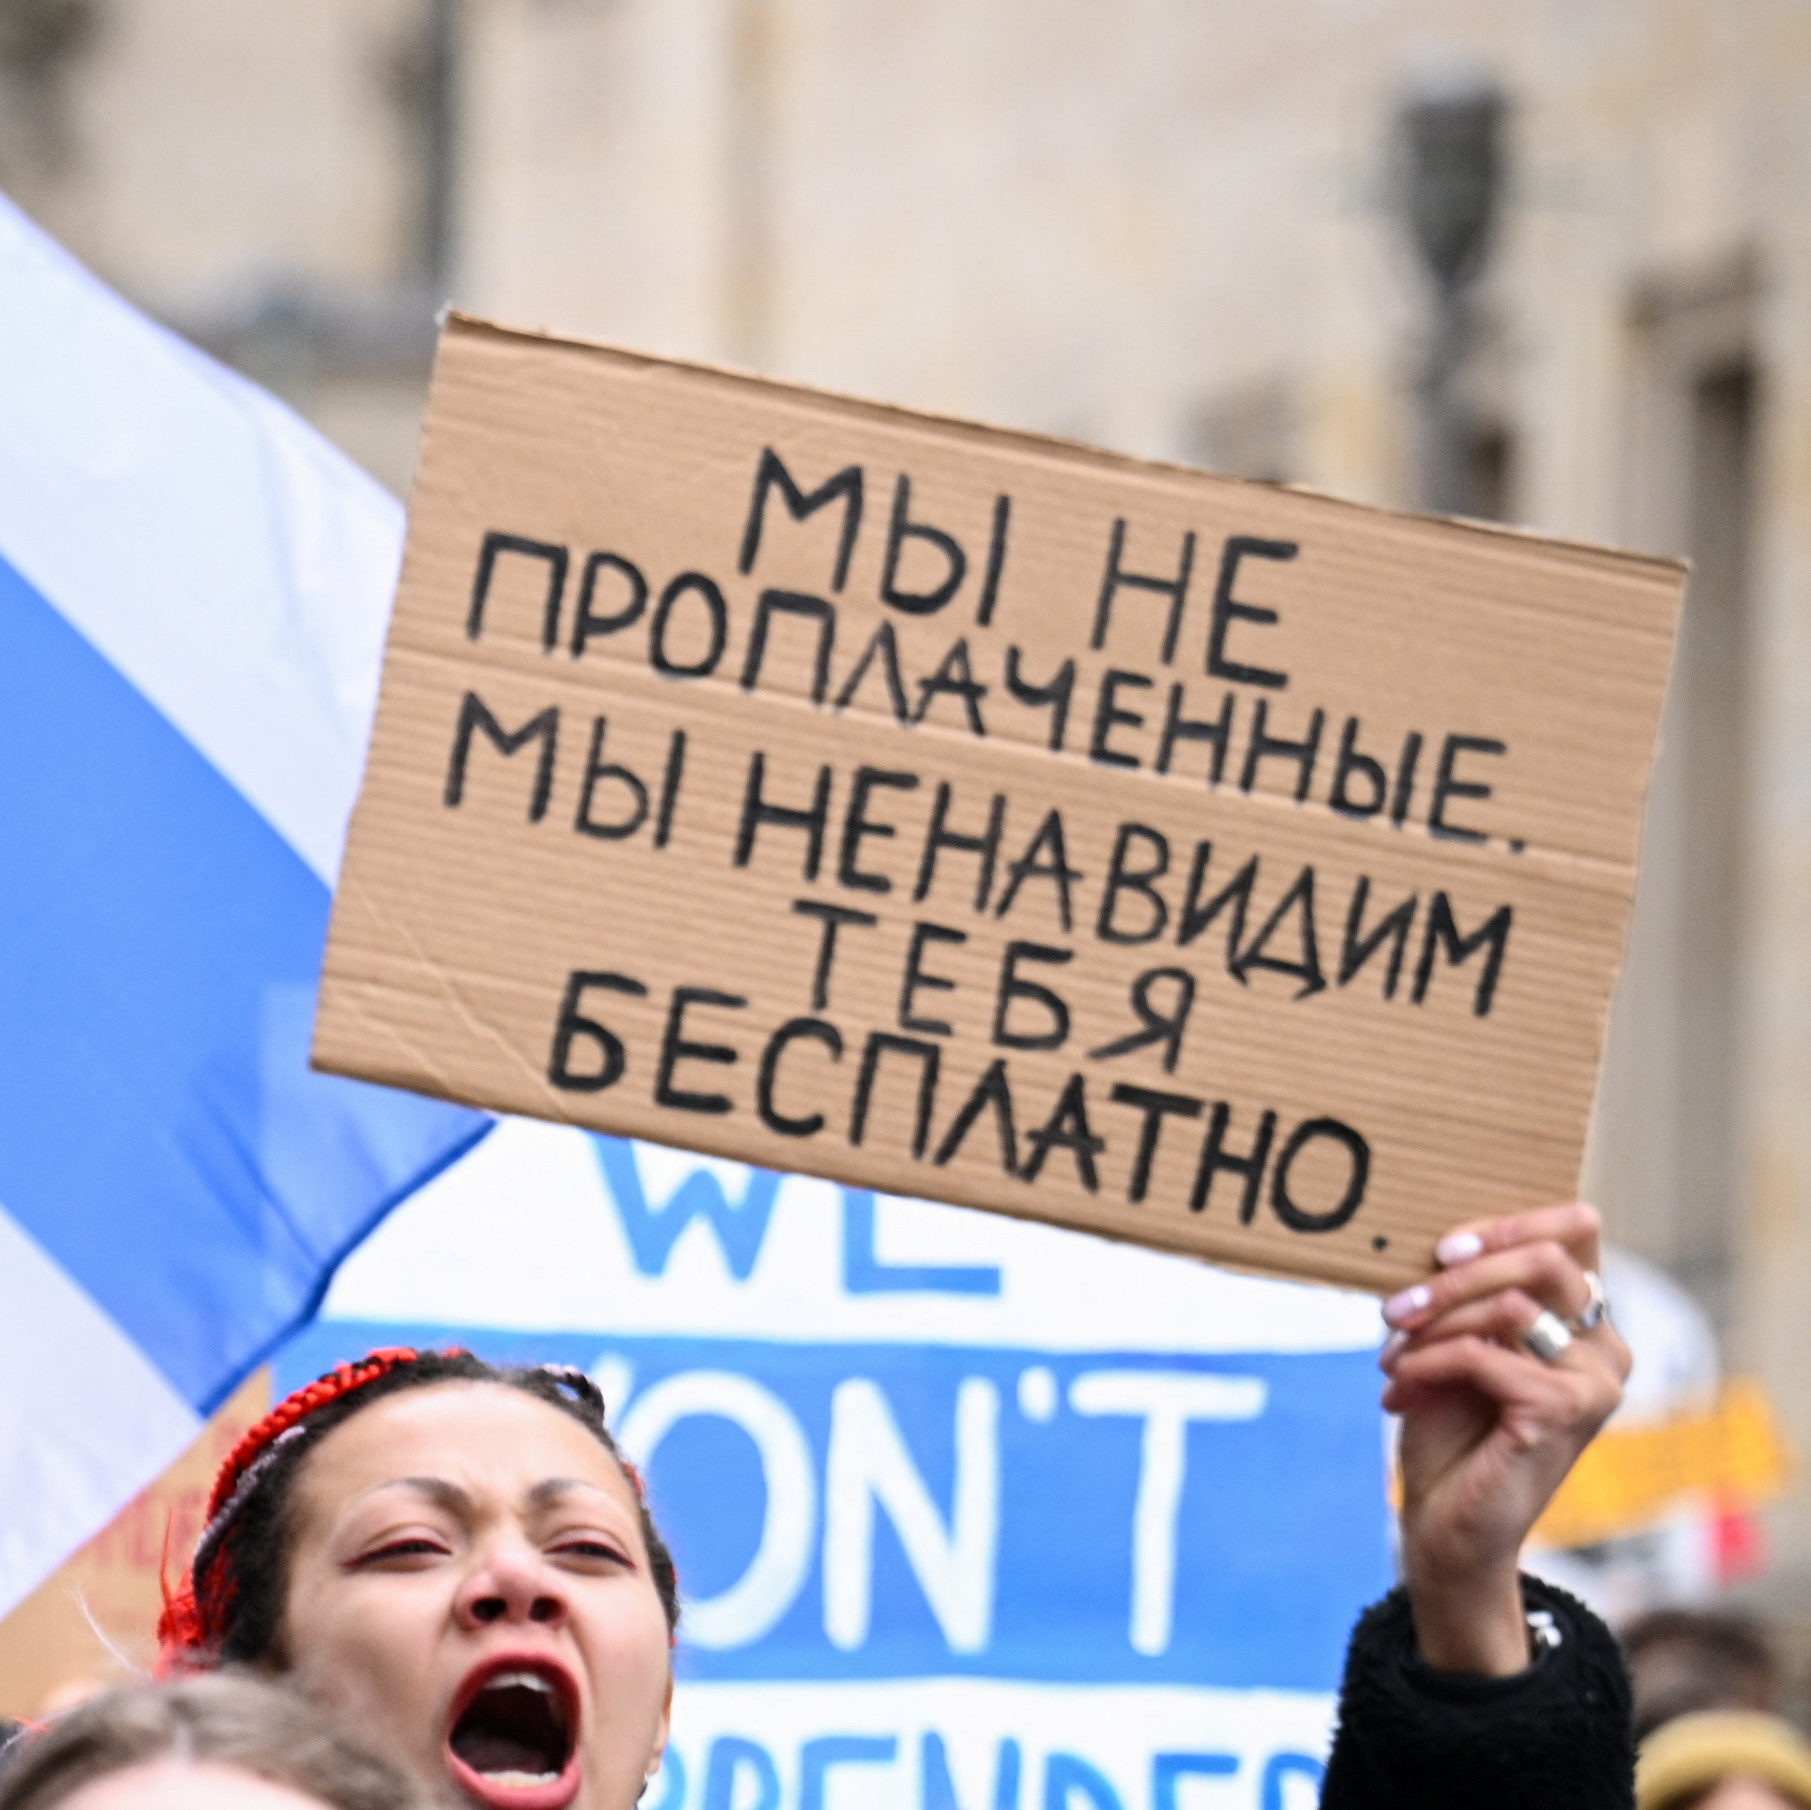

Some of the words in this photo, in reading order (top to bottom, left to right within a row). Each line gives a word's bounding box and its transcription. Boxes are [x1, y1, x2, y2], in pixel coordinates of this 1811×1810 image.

[467, 530, 1527, 853] ПРОПЛАЧЕННЫЕ.
[738, 446, 1011, 629] МЫ
[1091, 518, 1300, 690] НЕ
[445, 690, 687, 849] МЫ
[733, 751, 1514, 1018] НЕНАВИДИМ
[793, 897, 1197, 1075] ТЕБЯ
[547, 968, 1389, 1252] БЕСПЛАТНО.
[587, 1352, 1270, 1658] ON'T
